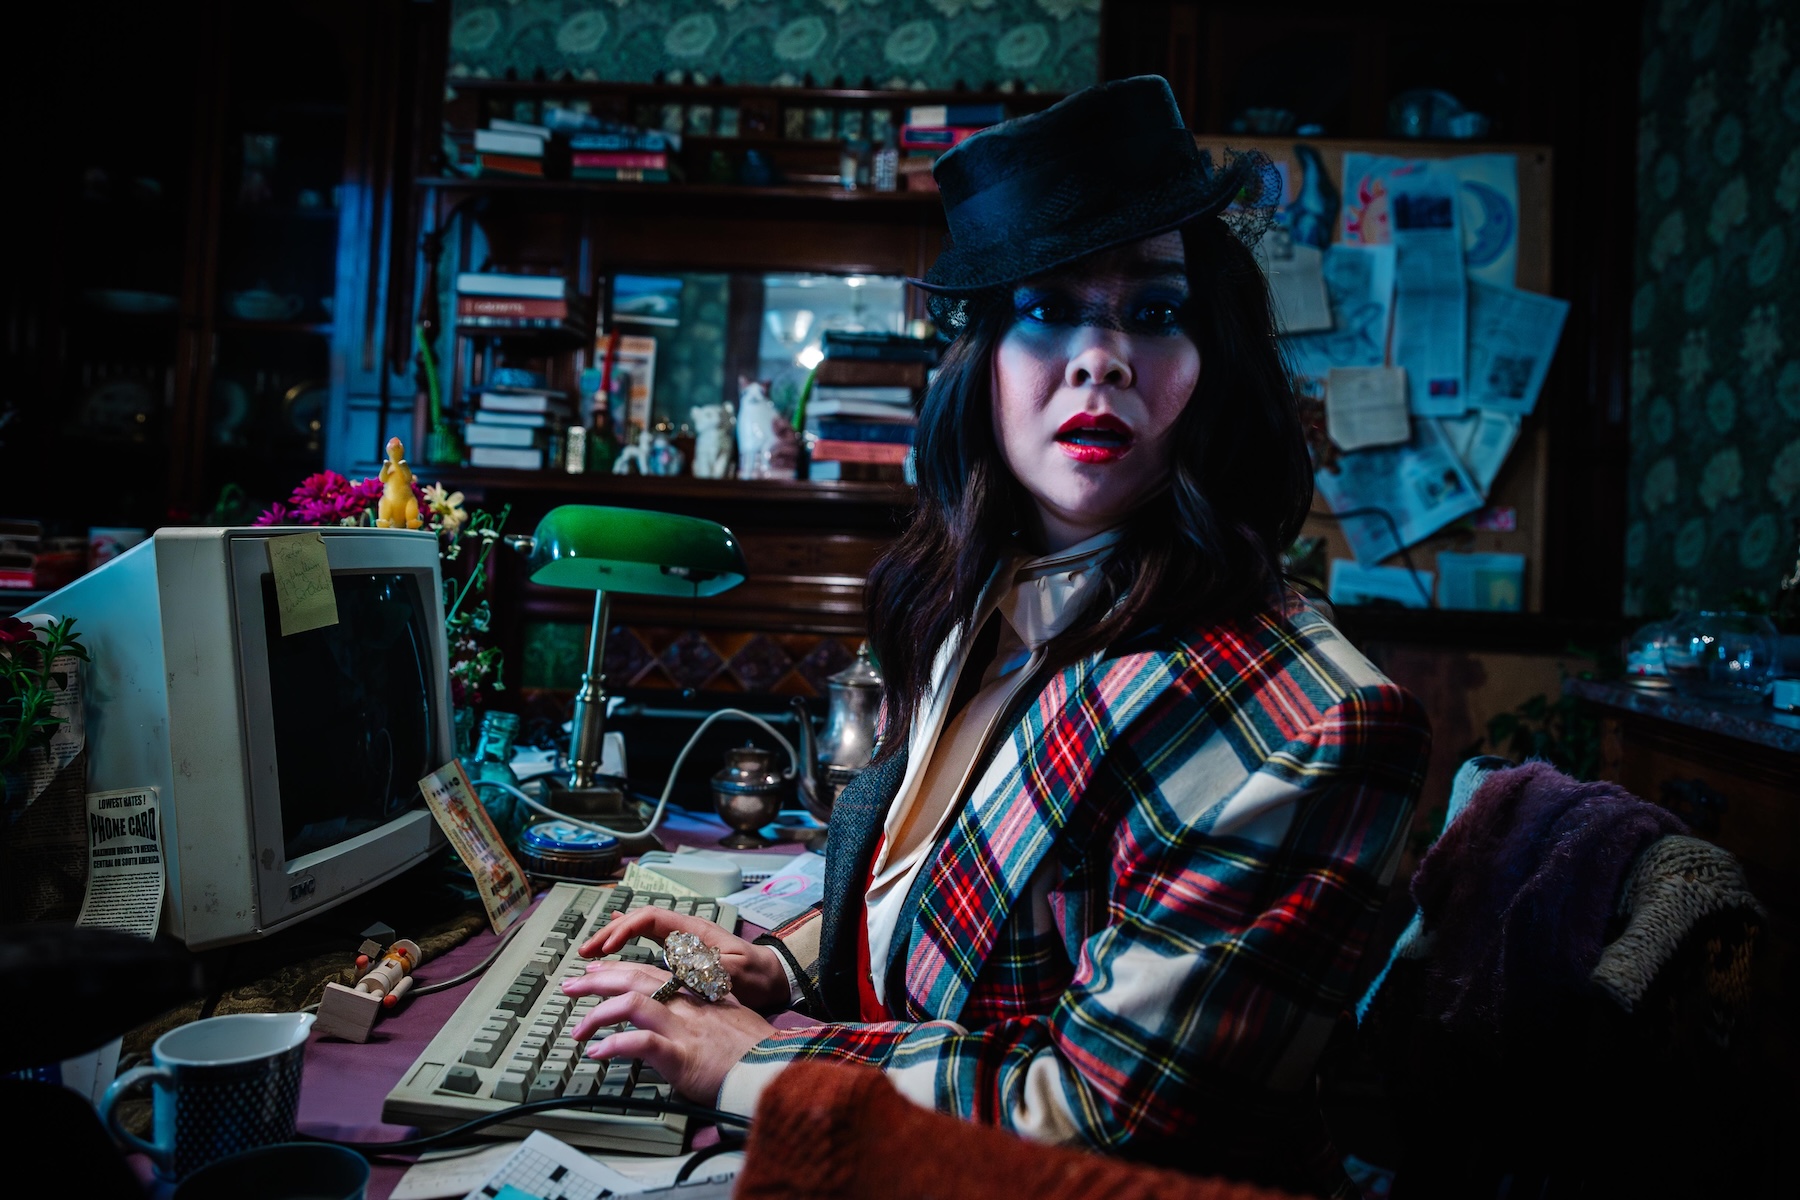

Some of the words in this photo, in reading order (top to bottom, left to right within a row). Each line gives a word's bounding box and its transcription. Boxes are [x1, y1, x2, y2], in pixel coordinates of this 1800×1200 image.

[98, 797, 123, 810] LOWEST
[90, 812, 127, 848] PHONE
[128, 807, 157, 842] CARD
[133, 845, 140, 854] TO
[93, 859, 114, 869] CENTRAL
[121, 857, 138, 867] SOUTH
[138, 855, 160, 865] AMERICA
